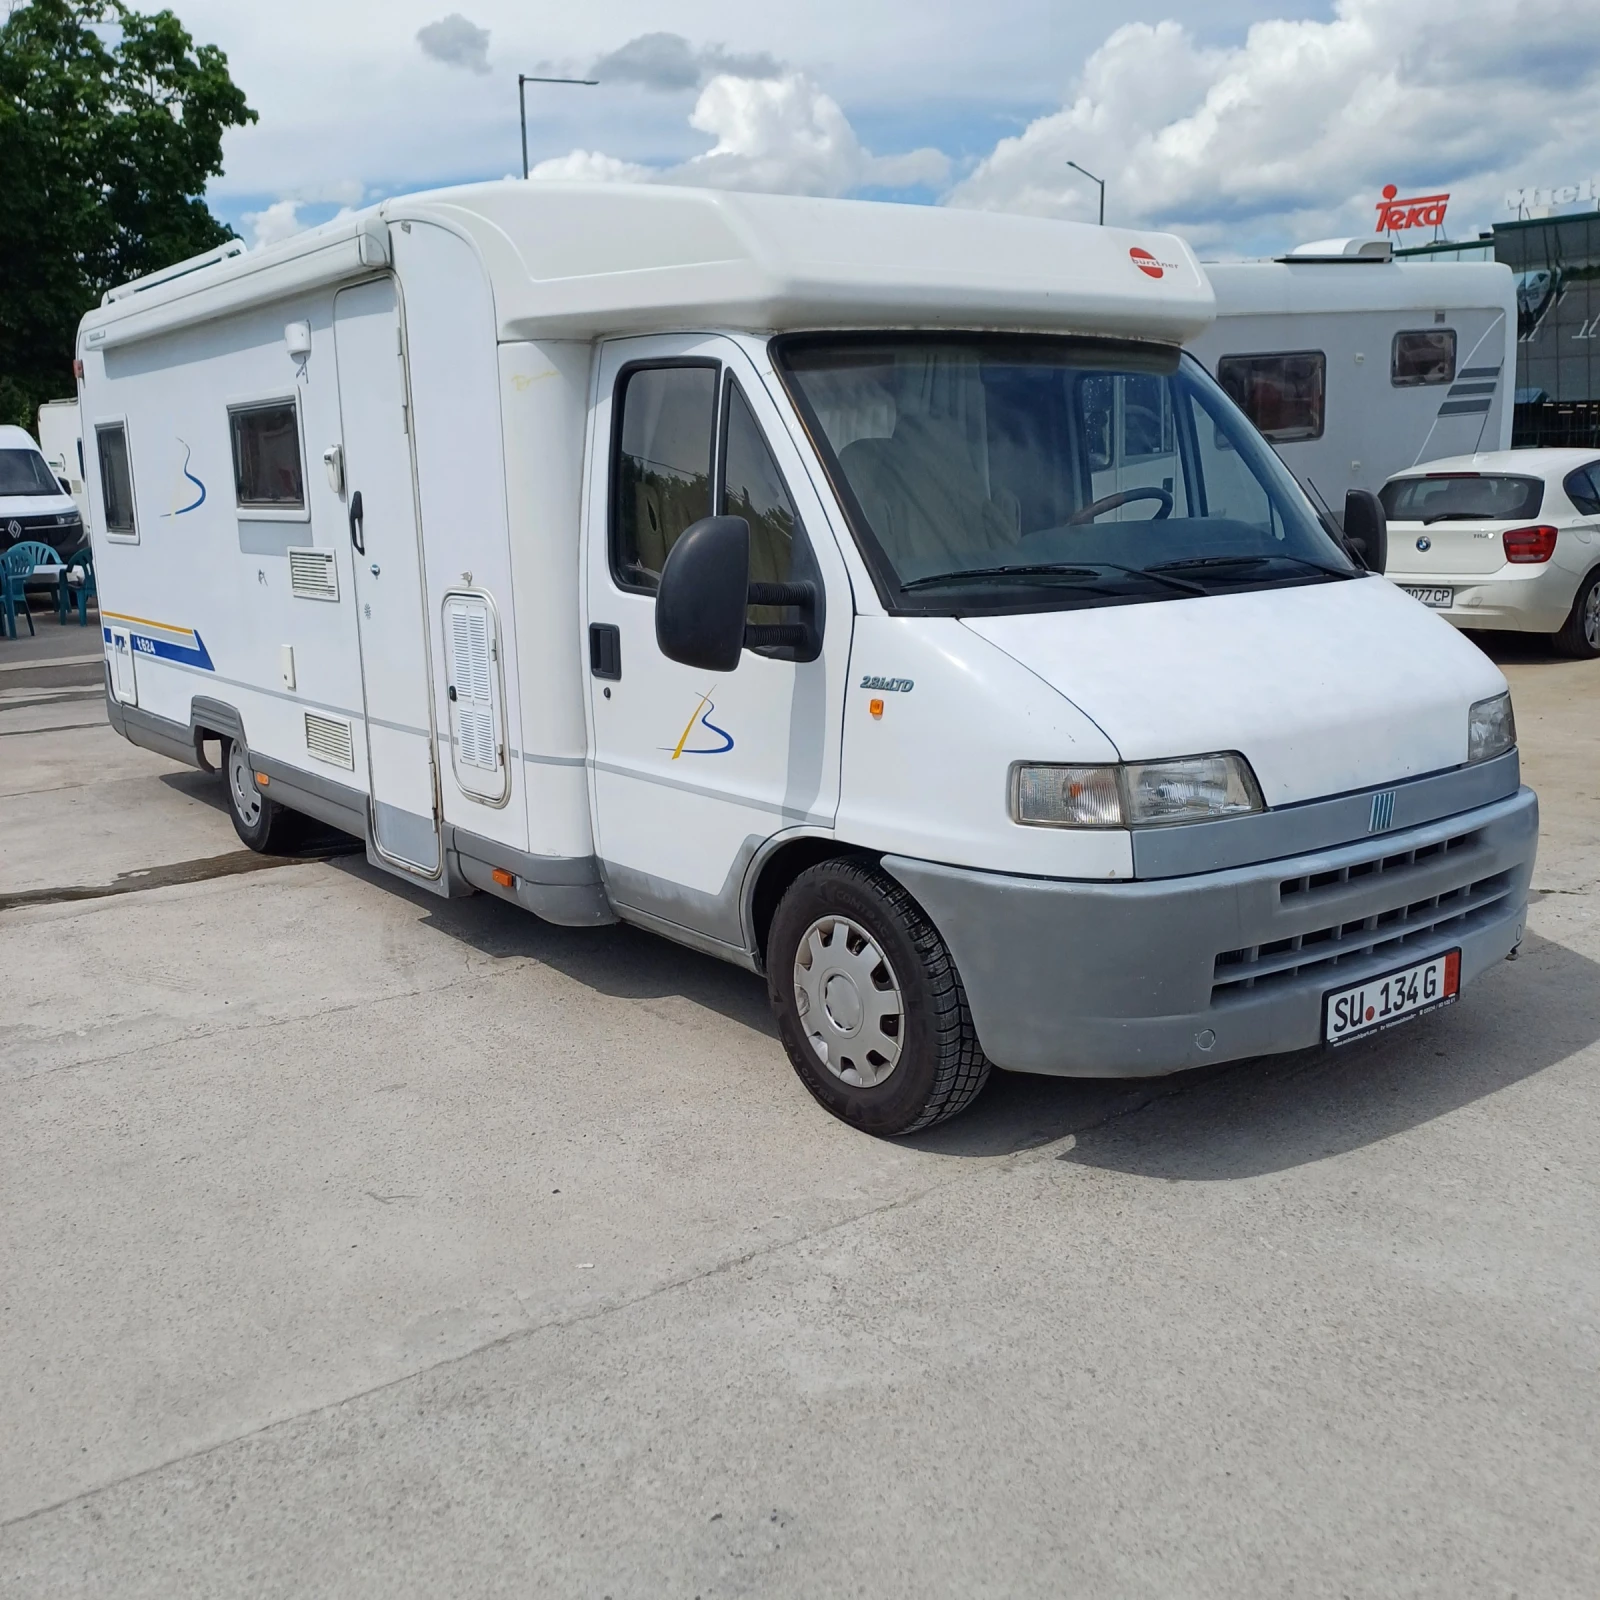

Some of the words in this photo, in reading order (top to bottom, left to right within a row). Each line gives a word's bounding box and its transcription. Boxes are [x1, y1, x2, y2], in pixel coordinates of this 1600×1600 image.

[1434, 590, 1450, 602] CP
[1333, 991, 1364, 1033] SU
[1379, 972, 1418, 1017] 134
[1424, 965, 1437, 999] G
